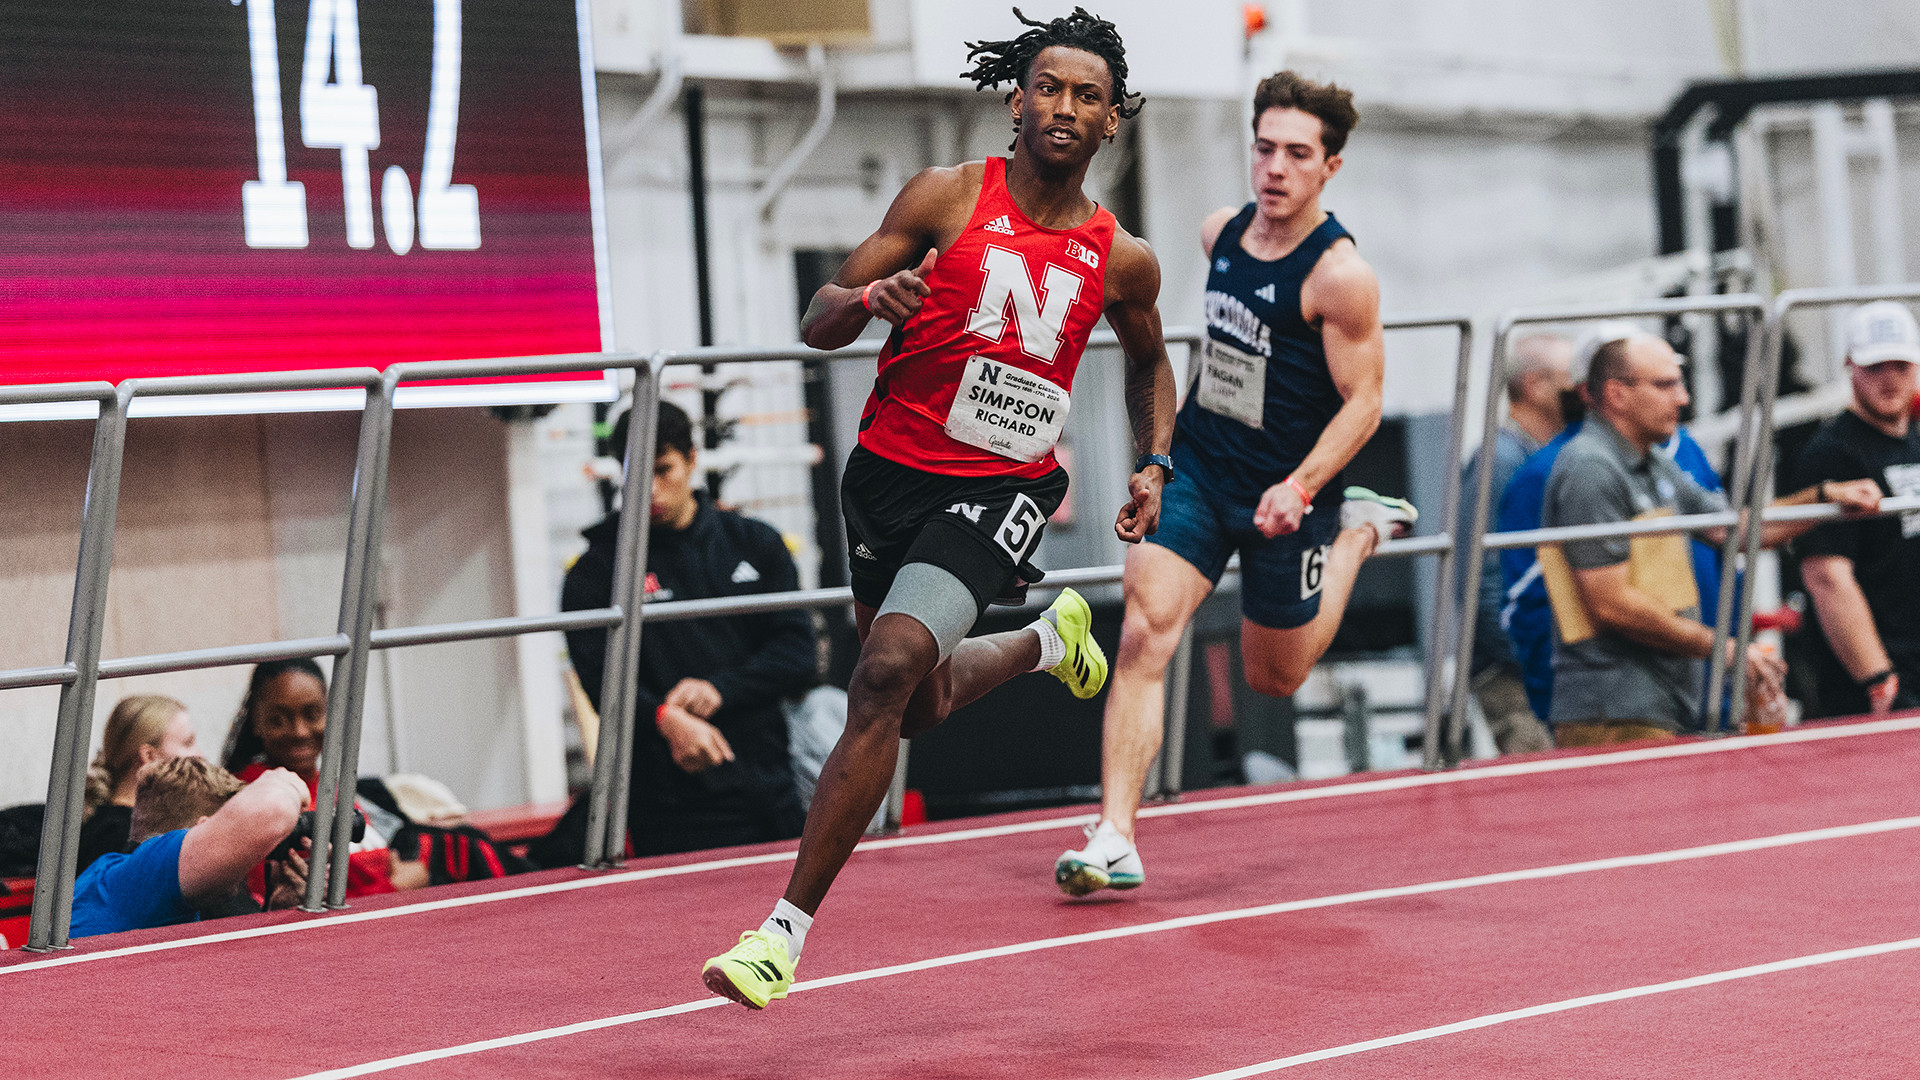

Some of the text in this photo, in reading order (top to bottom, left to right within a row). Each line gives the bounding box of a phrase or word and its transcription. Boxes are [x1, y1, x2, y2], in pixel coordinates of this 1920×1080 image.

[230, 0, 482, 255] 14.2
[984, 224, 1015, 236] adidas
[963, 243, 1085, 366] N
[979, 362, 1002, 385] N
[1005, 373, 1037, 388] Graduate
[968, 385, 1055, 424] SIMPSON
[975, 408, 1036, 436] RICHARD
[1003, 500, 1038, 553] 5
[1306, 547, 1323, 590] 6
